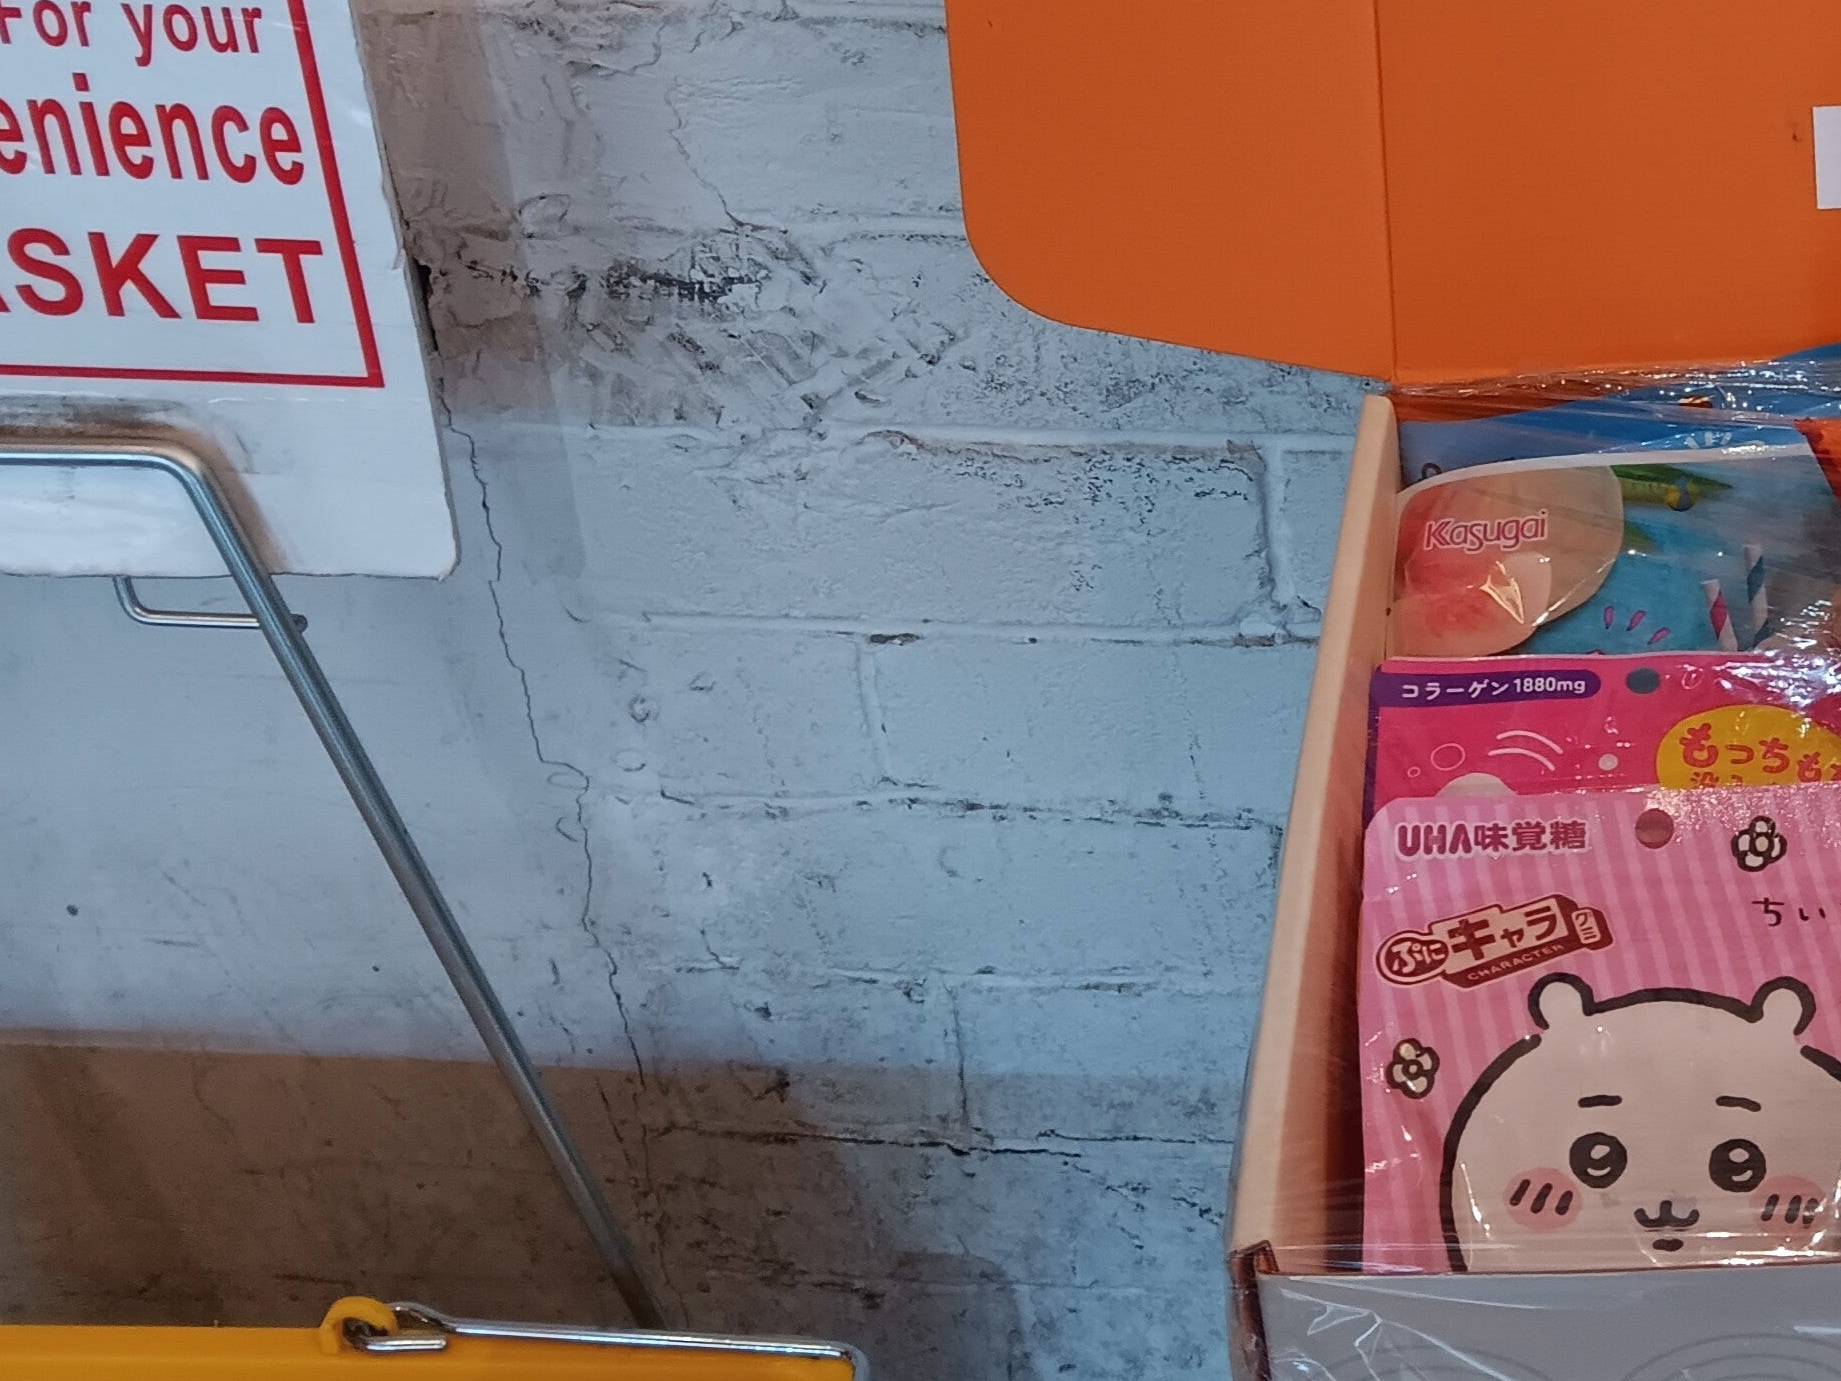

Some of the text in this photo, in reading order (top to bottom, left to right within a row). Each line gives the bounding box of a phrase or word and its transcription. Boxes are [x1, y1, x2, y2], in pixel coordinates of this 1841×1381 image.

[120, 2, 262, 67] your
[1423, 509, 1549, 552] Kasugai
[1397, 820, 1588, 857] UHA味覚糖
[1467, 944, 1564, 981] CHARACTER
